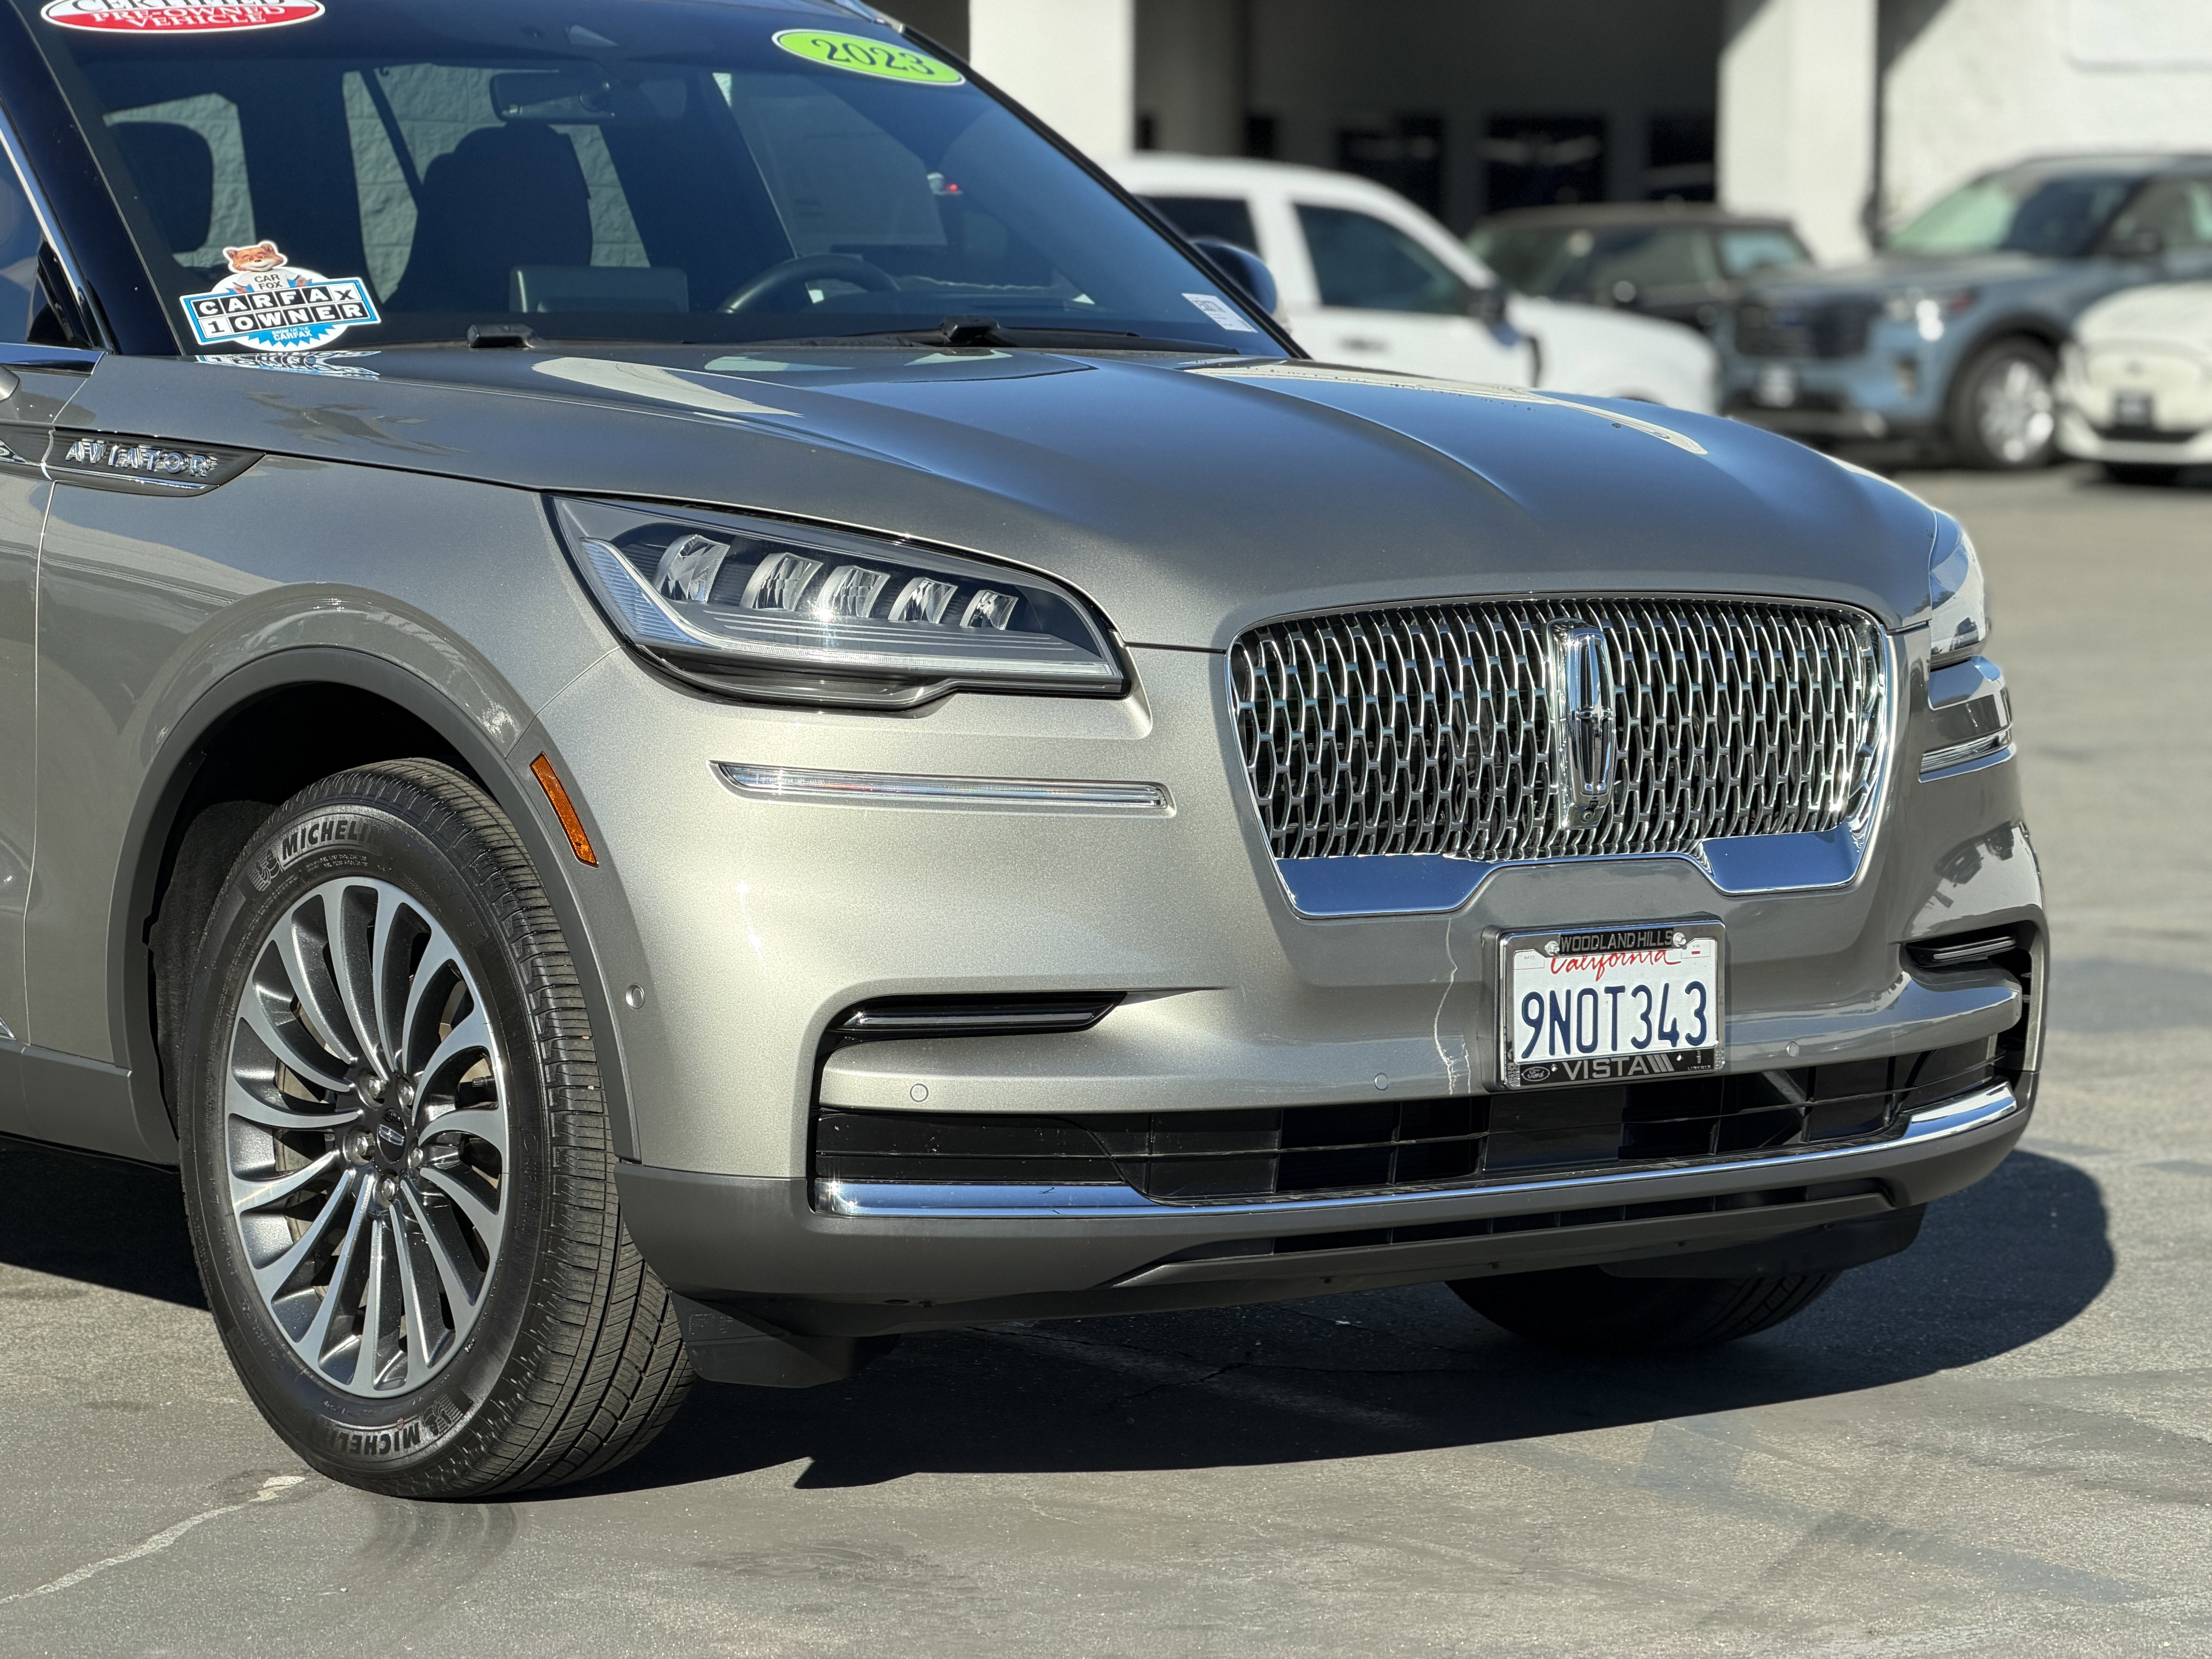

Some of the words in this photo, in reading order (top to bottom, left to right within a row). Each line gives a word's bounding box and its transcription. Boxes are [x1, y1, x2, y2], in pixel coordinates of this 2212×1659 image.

[91, 5, 285, 22] PRE-OWNED
[126, 12, 266, 27] VEHICLE
[812, 39, 934, 75] 2023
[254, 273, 280, 283] CAR
[258, 280, 283, 290] FOX
[199, 289, 357, 315] CARFAX
[207, 320, 225, 334] 1
[234, 304, 363, 330] OWNER
[273, 330, 313, 340] CARFAX
[65, 440, 212, 477] AVIATOR
[283, 820, 380, 860] MICHELIN
[1561, 932, 1635, 952] WOODLAND
[1637, 930, 1673, 947] HILLS
[1551, 950, 1681, 982] California
[1521, 981, 1707, 1059] 9NOT343
[1562, 1054, 1649, 1081] VISTA
